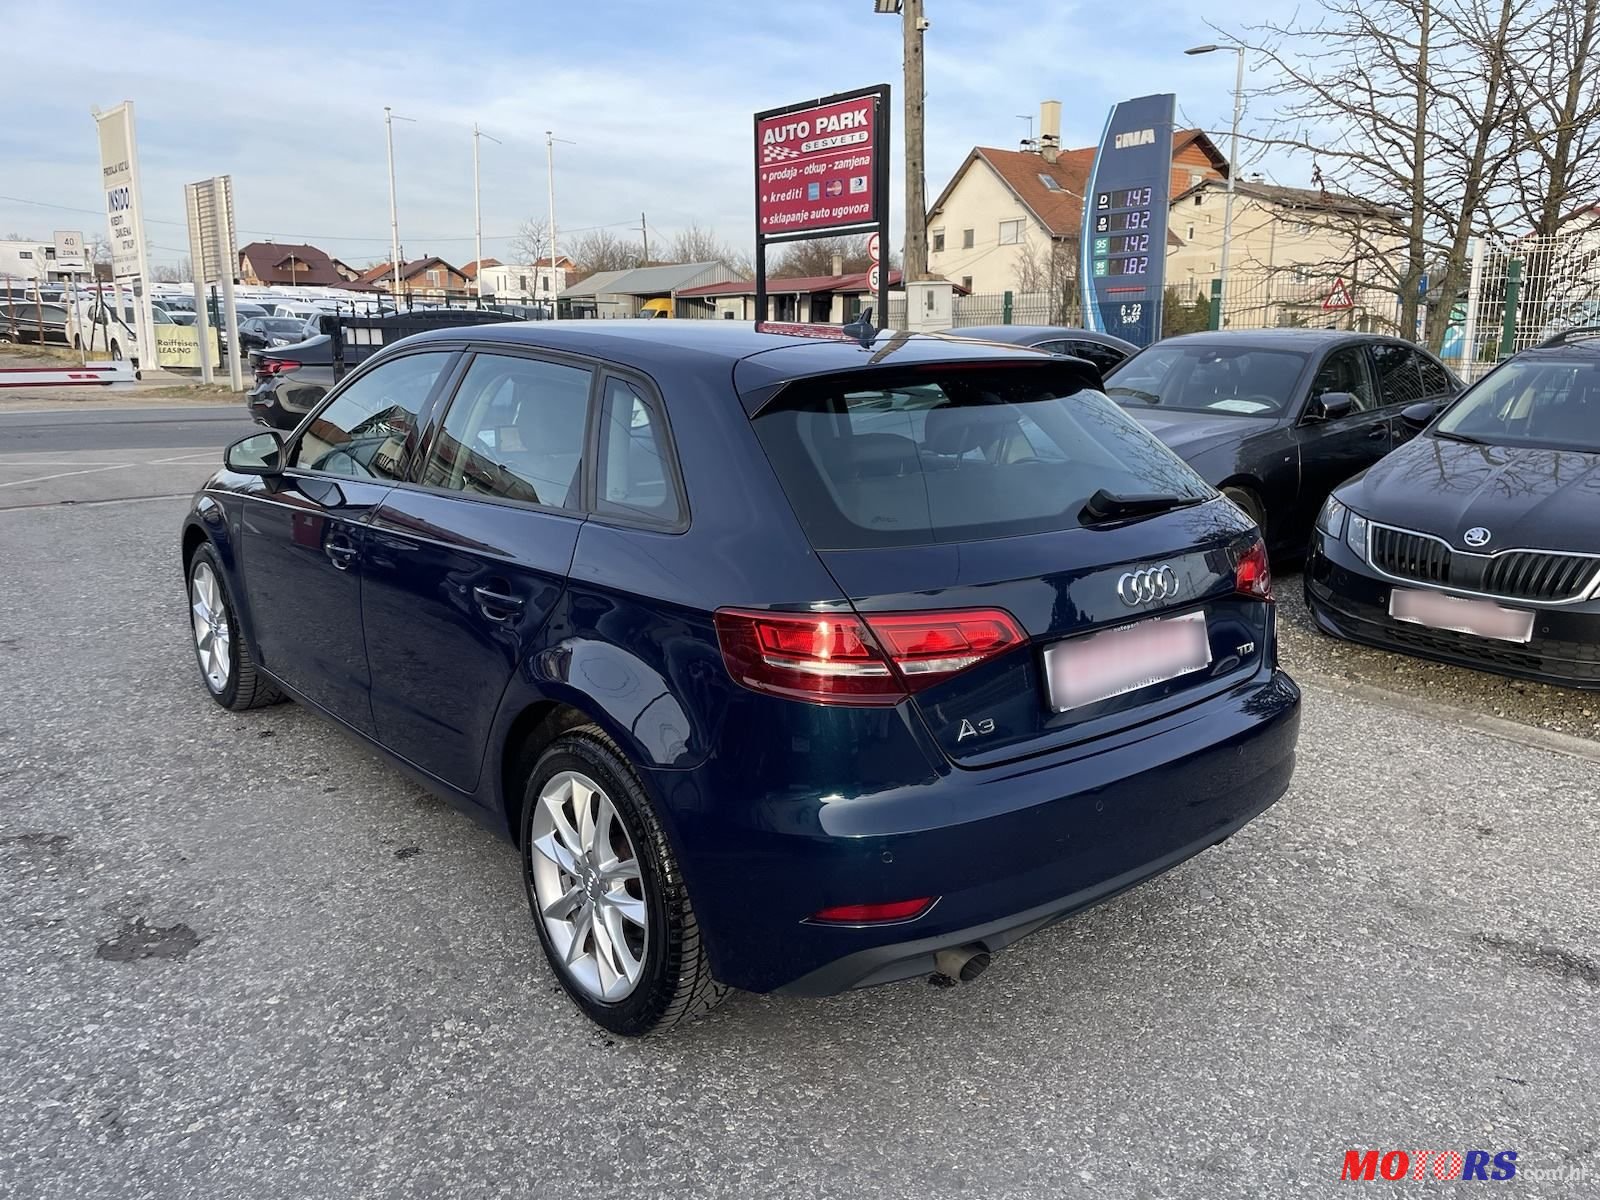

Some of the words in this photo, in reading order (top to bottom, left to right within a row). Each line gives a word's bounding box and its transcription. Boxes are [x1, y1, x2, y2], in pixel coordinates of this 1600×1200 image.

[763, 121, 810, 145] AUTO
[816, 108, 868, 135] PARK
[805, 132, 866, 151] SESVETE
[768, 166, 797, 183] prodaja
[804, 162, 827, 175] otkup
[833, 155, 870, 170] zamjena
[770, 188, 803, 203] krediti
[769, 208, 808, 225] sklapanje
[810, 207, 830, 219] auto
[832, 203, 870, 218] ugovora
[64, 237, 75, 246] 40
[157, 339, 199, 347] Raiffeisen
[957, 718, 995, 742] A3
